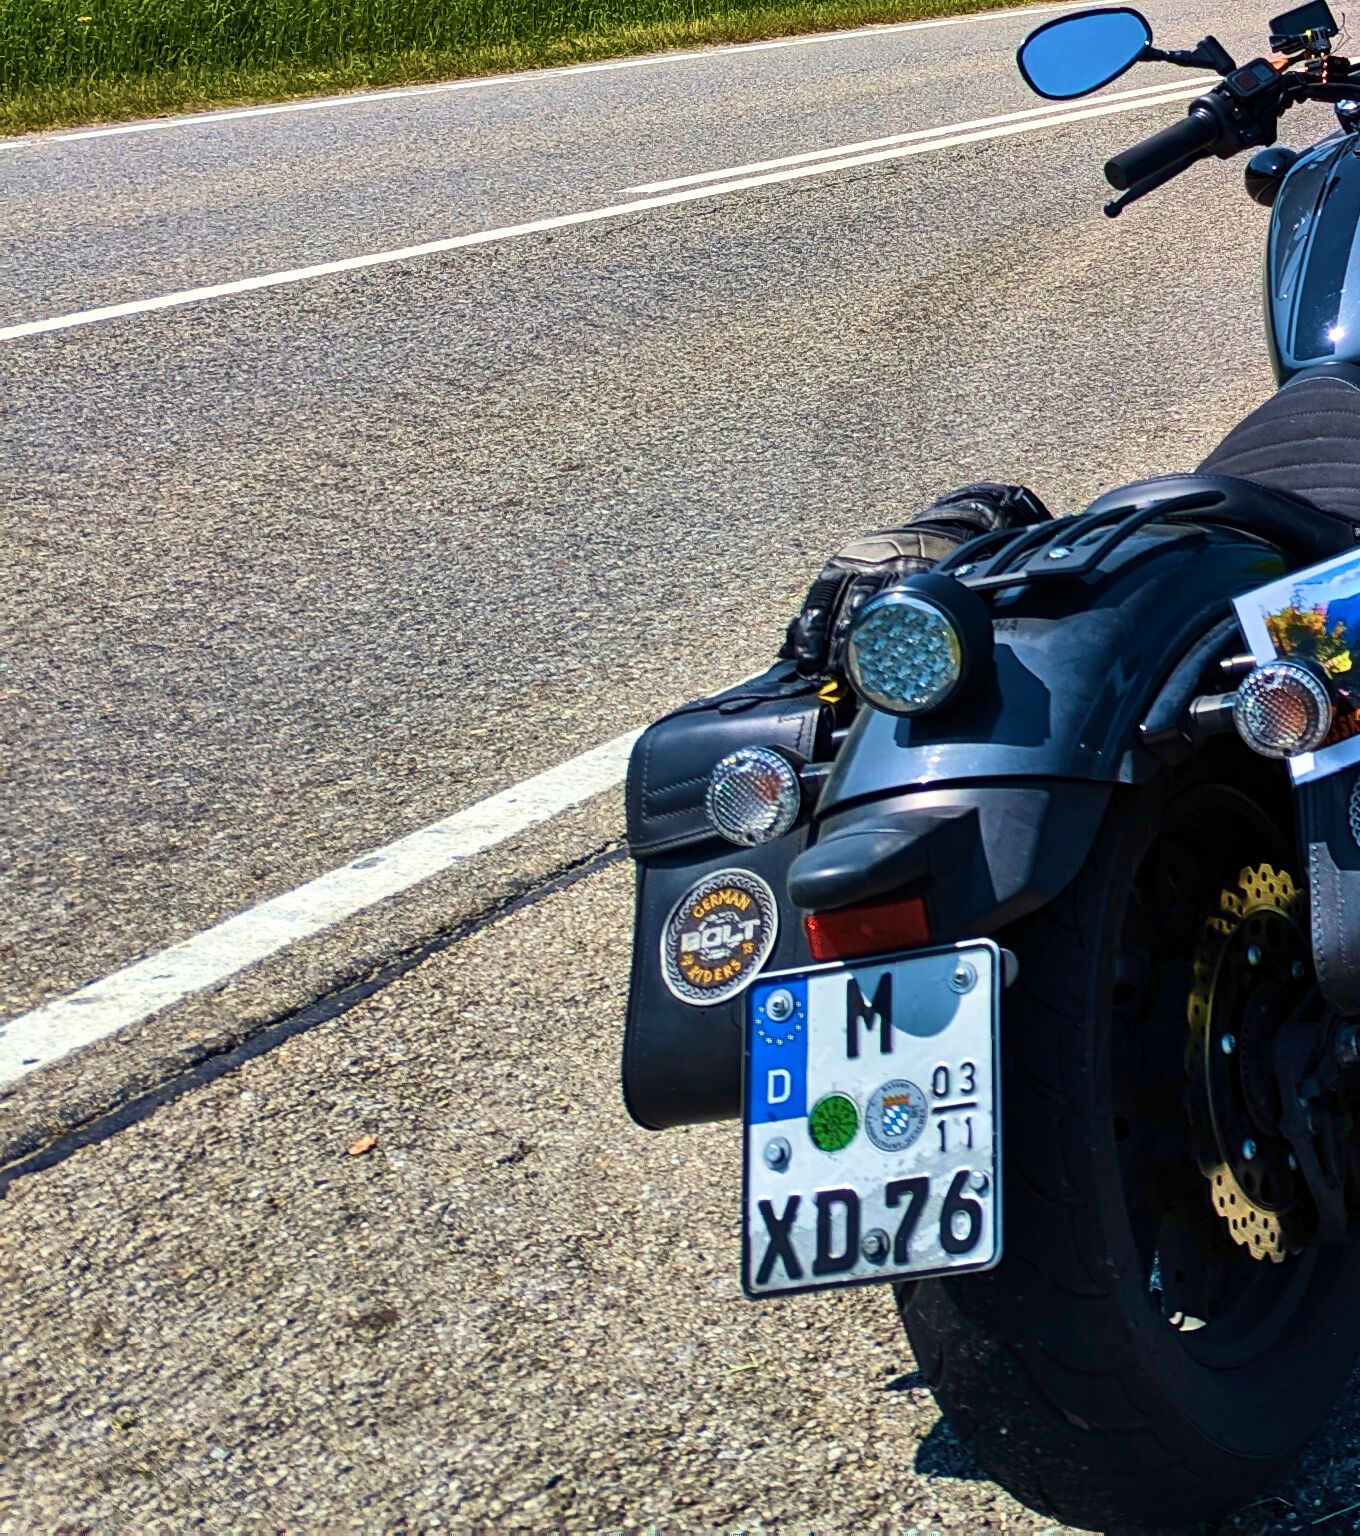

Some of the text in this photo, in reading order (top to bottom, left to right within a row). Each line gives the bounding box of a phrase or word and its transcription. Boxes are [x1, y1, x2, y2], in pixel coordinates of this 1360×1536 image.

[692, 889, 751, 918] GERMAN
[680, 919, 761, 953] BOLT
[687, 959, 741, 983] RIDERS
[846, 971, 893, 1058] M
[767, 1068, 792, 1105] D
[932, 1061, 977, 1098] 03
[937, 1116, 975, 1152] 11
[755, 1169, 984, 1286] XD 76
